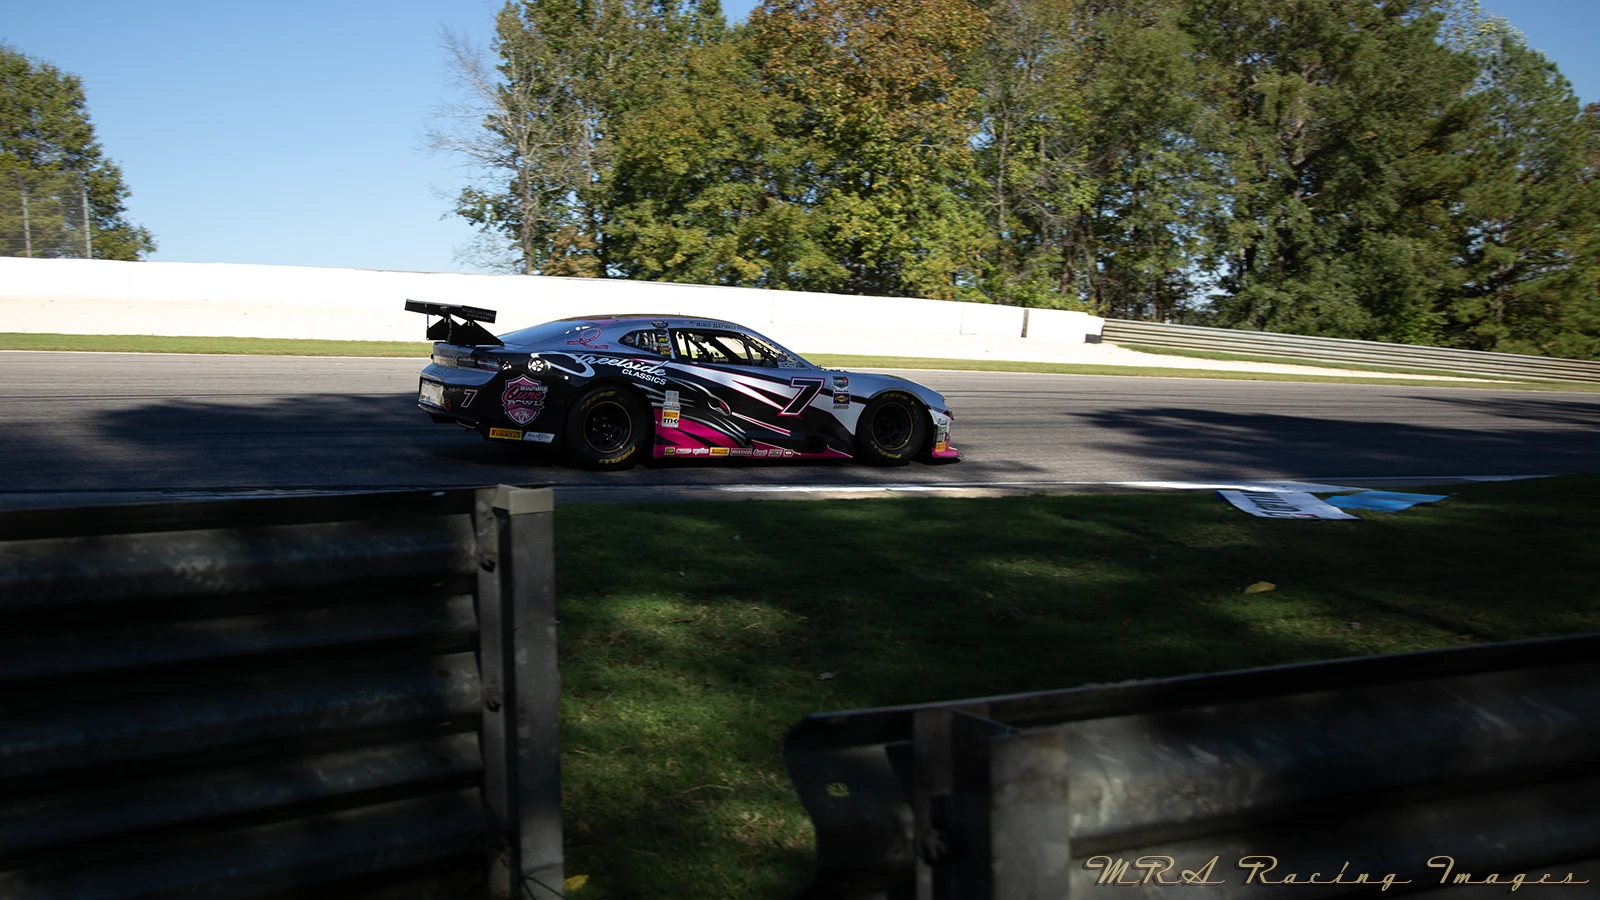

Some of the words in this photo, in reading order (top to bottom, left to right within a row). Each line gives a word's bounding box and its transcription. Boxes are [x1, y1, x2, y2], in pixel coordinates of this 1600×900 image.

[621, 368, 667, 385] CLASSICS
[460, 389, 478, 408] 7
[503, 384, 543, 401] Cure
[778, 376, 826, 417] 7
